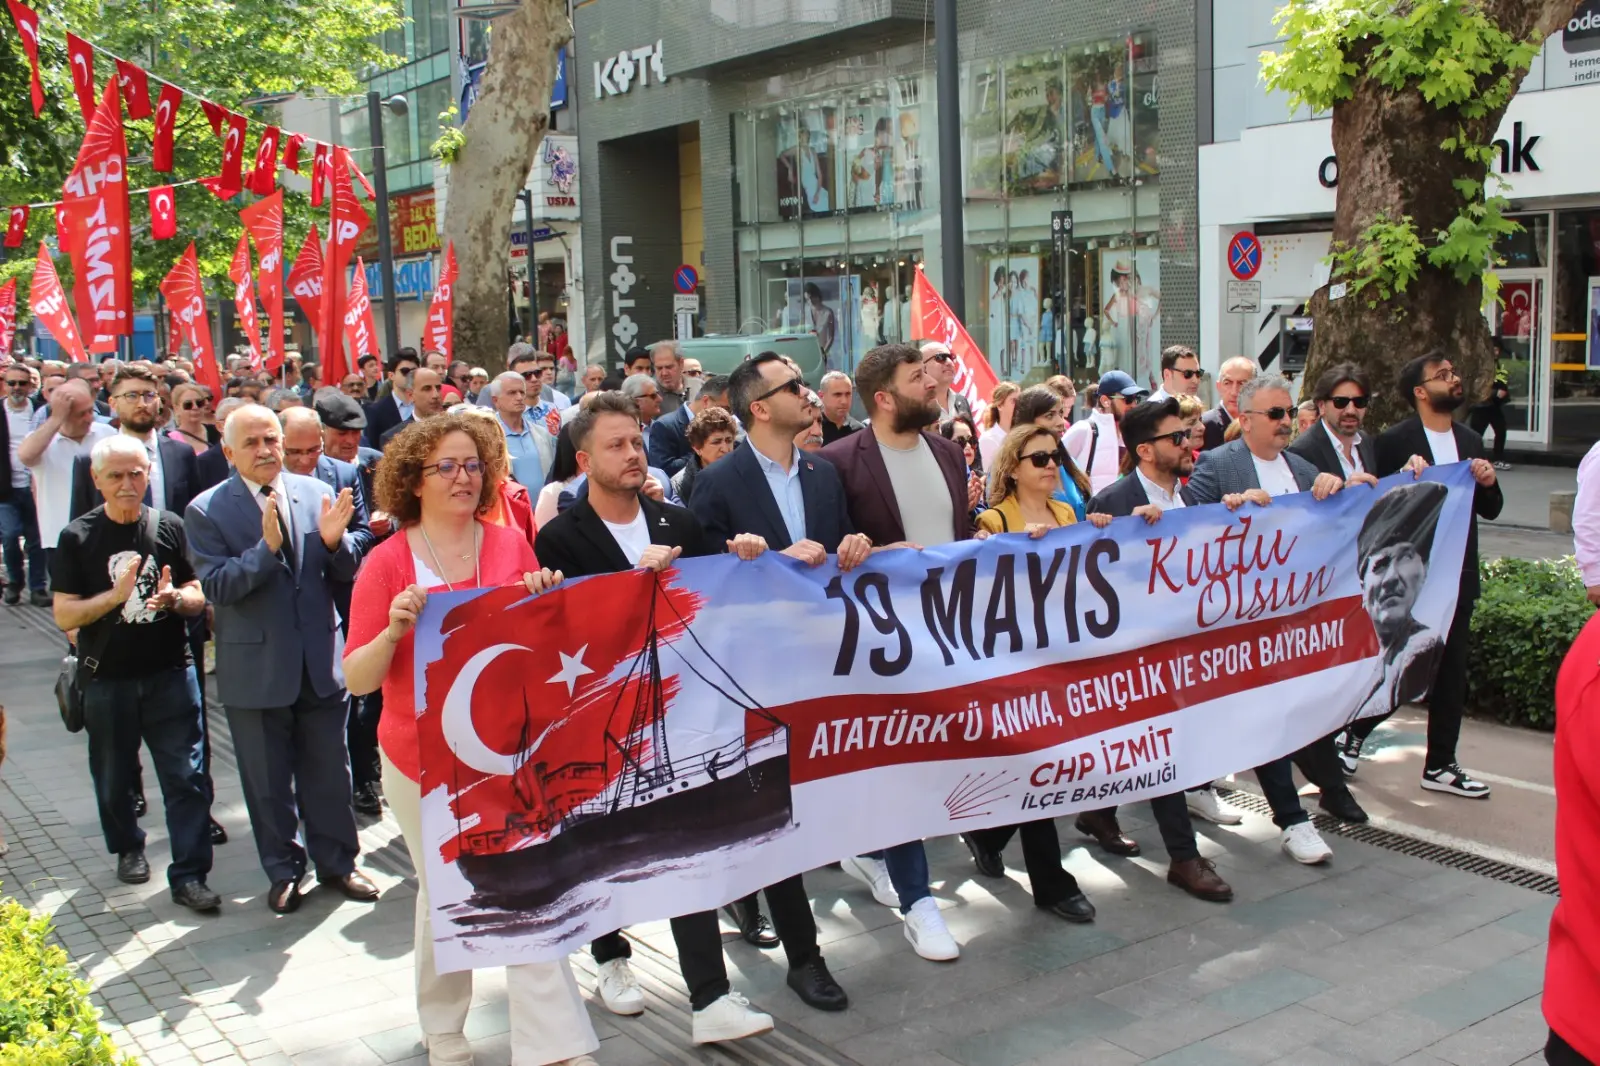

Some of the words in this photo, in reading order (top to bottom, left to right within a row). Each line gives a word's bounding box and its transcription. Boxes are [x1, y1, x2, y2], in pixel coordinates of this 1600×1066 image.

[546, 196, 576, 207] USPA
[1146, 515, 1298, 595] Kutlu
[823, 572, 913, 677] 19
[920, 538, 1121, 667] MAYIS
[1196, 564, 1336, 629] Olsun
[808, 700, 983, 760] ATATÜRK'Ü
[991, 690, 1064, 741] ANMA,
[1066, 655, 1166, 718] GENÇLİK
[1168, 653, 1195, 691] VE
[1199, 640, 1254, 685] SPOR
[1258, 618, 1345, 668] BAYRAMI
[1021, 789, 1068, 811] İLÇE
[1070, 762, 1177, 803] BAŞKANLIĞI
[1030, 752, 1096, 788] CHP
[1100, 725, 1173, 776] İZMİT
